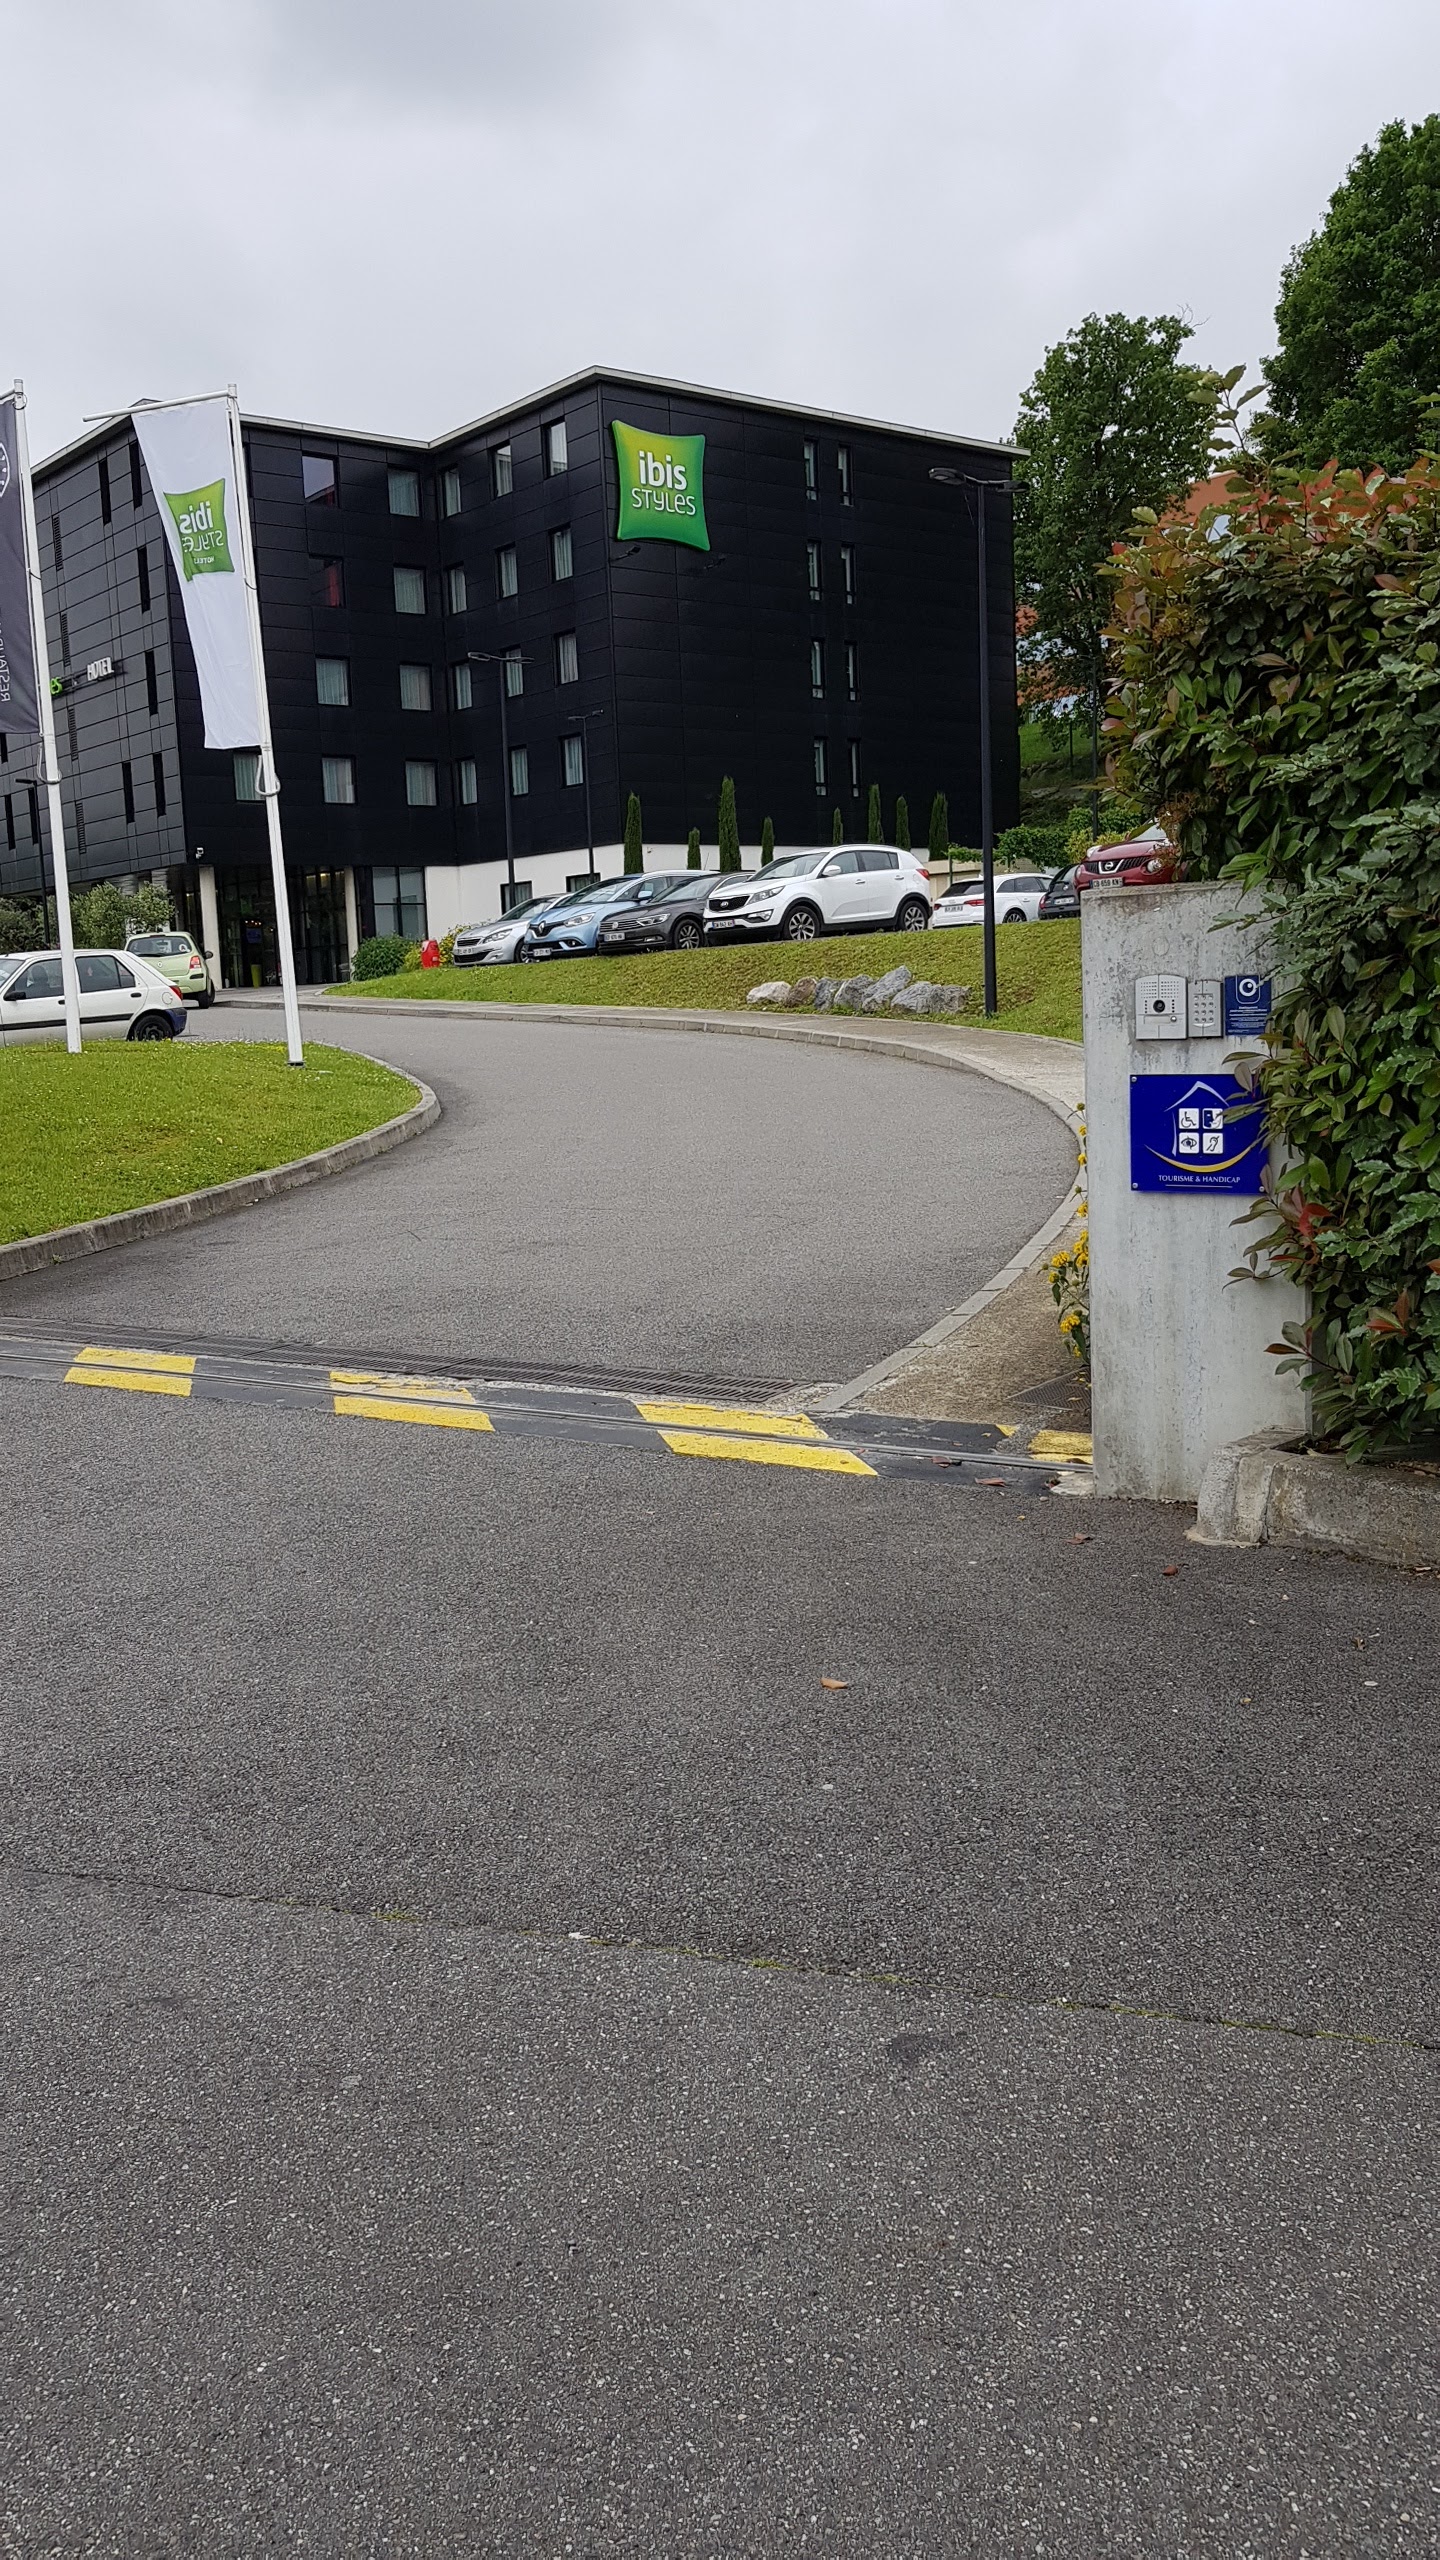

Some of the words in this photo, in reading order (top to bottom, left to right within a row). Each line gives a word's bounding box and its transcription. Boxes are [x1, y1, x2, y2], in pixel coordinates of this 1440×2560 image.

[638, 450, 688, 491] ibis
[87, 657, 115, 681] HOTEL
[1158, 1174, 1194, 1182] TOURISME
[1195, 1175, 1201, 1183] &
[1202, 1176, 1241, 1184] HANDICAP
